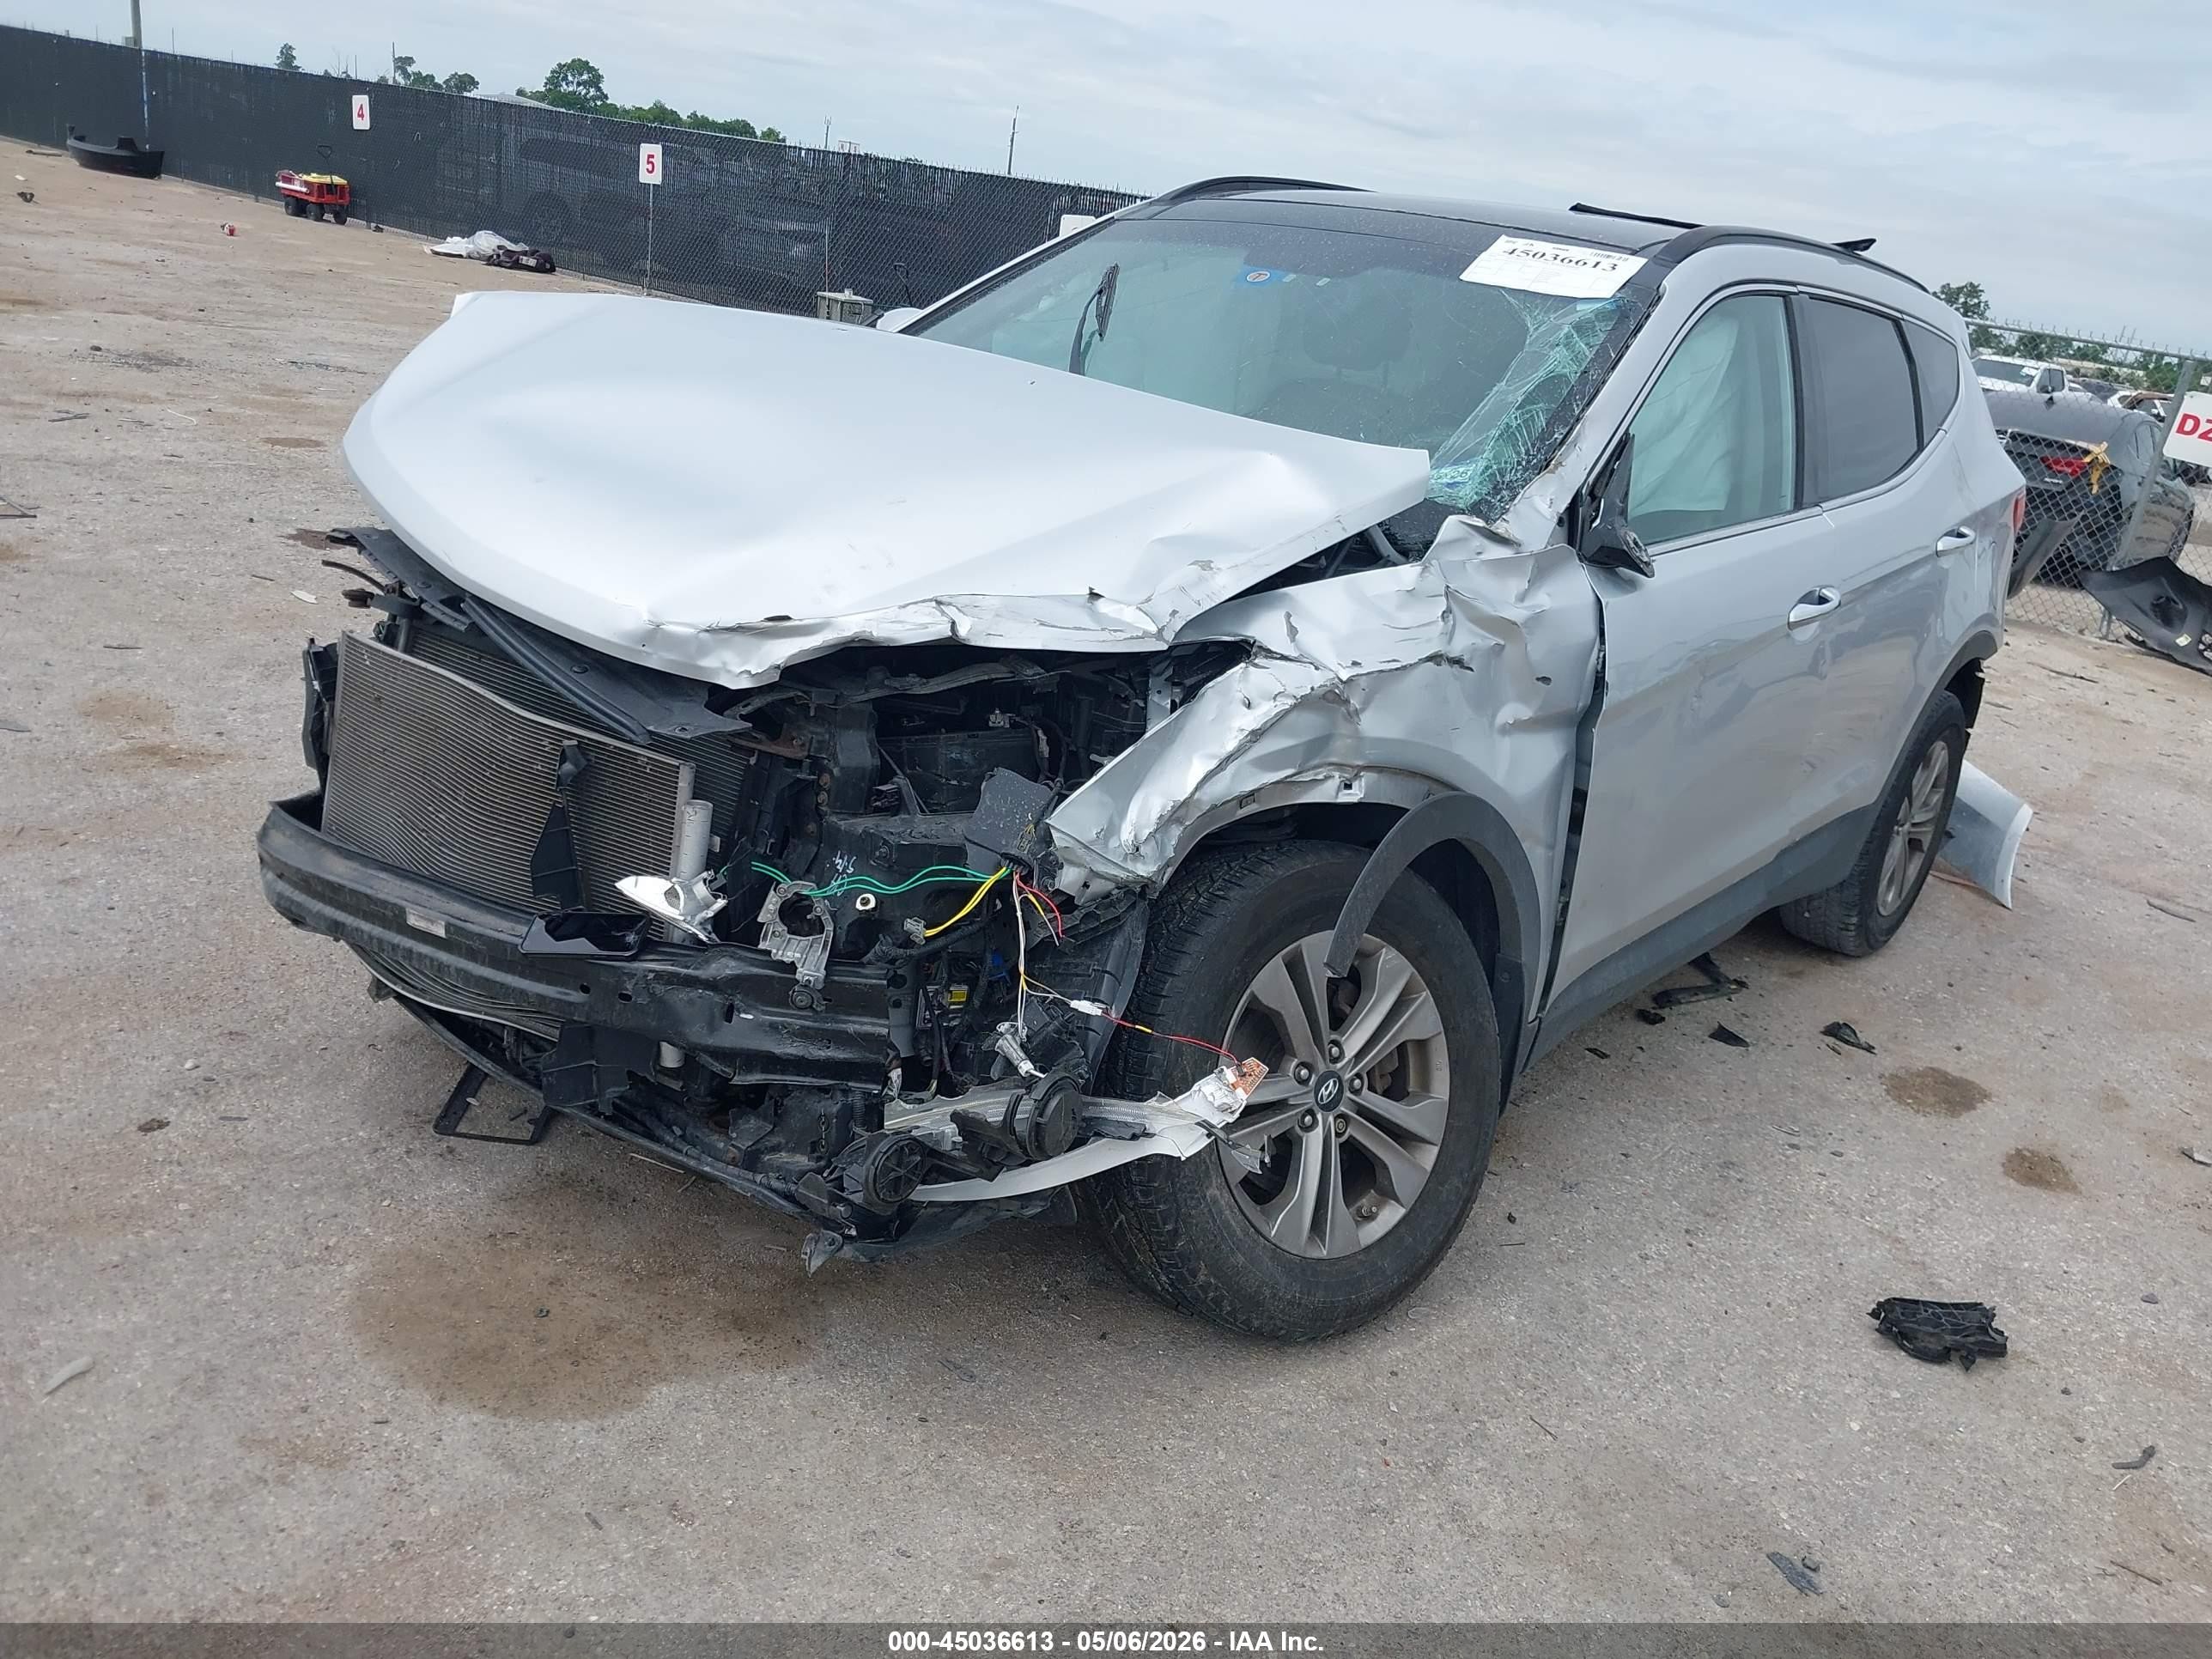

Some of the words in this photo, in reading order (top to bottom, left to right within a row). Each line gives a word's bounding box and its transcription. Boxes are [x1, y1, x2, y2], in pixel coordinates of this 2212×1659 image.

[356, 104, 365, 120] 4
[646, 153, 655, 174] 5
[1503, 247, 1619, 272] 45036613
